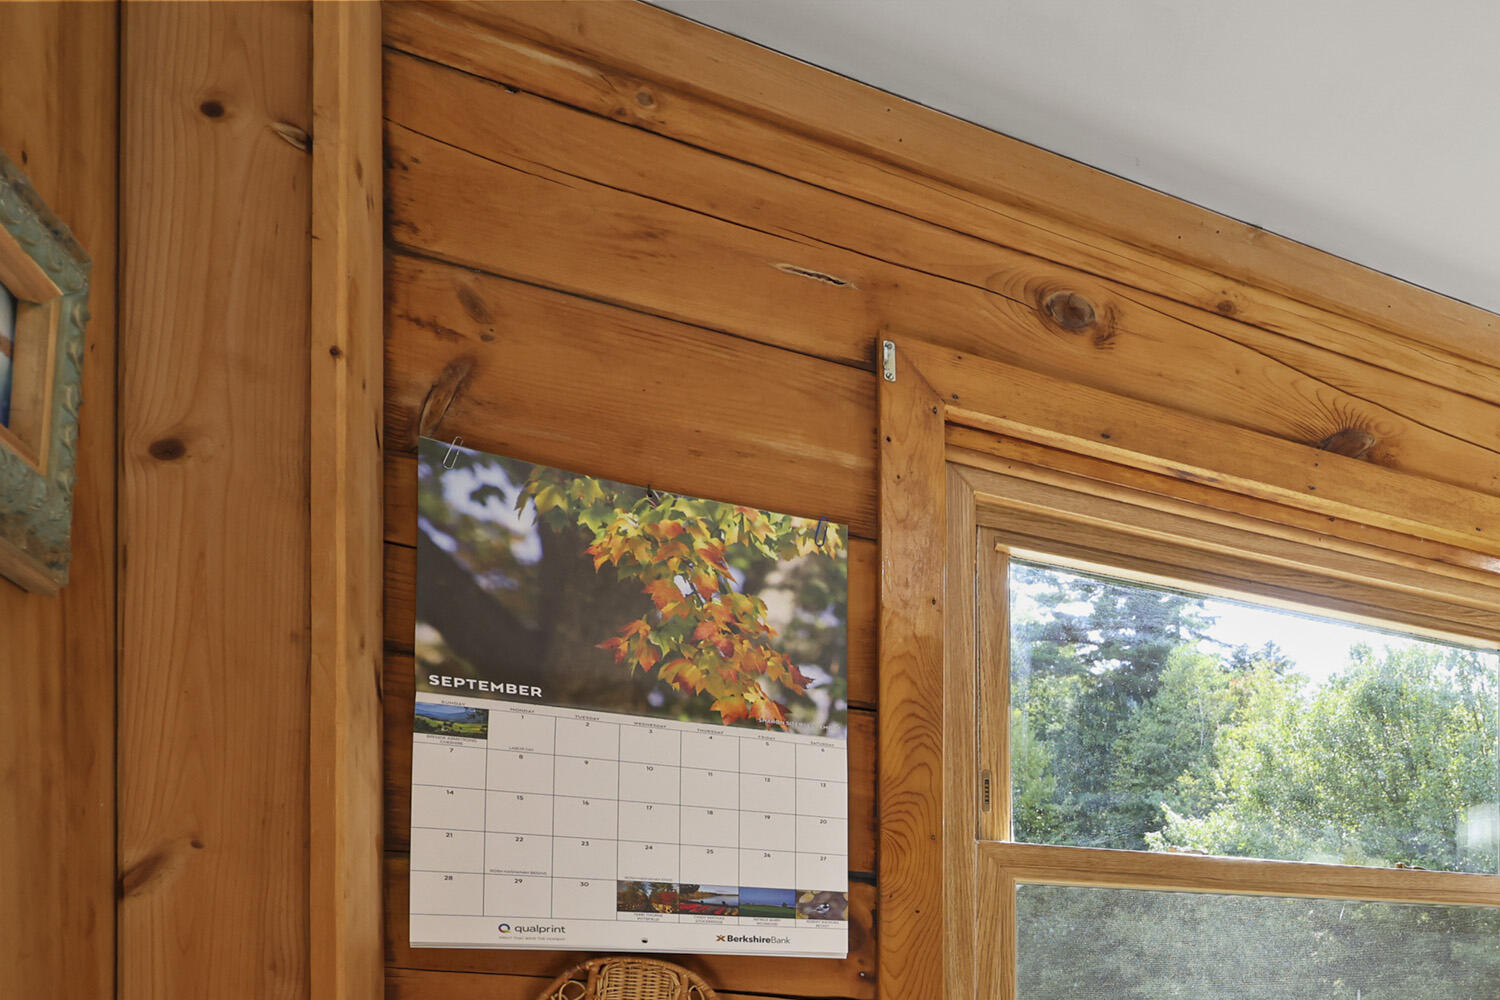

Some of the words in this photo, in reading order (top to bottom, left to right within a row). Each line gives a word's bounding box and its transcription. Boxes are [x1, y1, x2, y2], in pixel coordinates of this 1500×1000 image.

[428, 675, 543, 698] SEPTEMBER
[514, 923, 566, 934] qualprint
[727, 934, 791, 945] BerkshireBank
